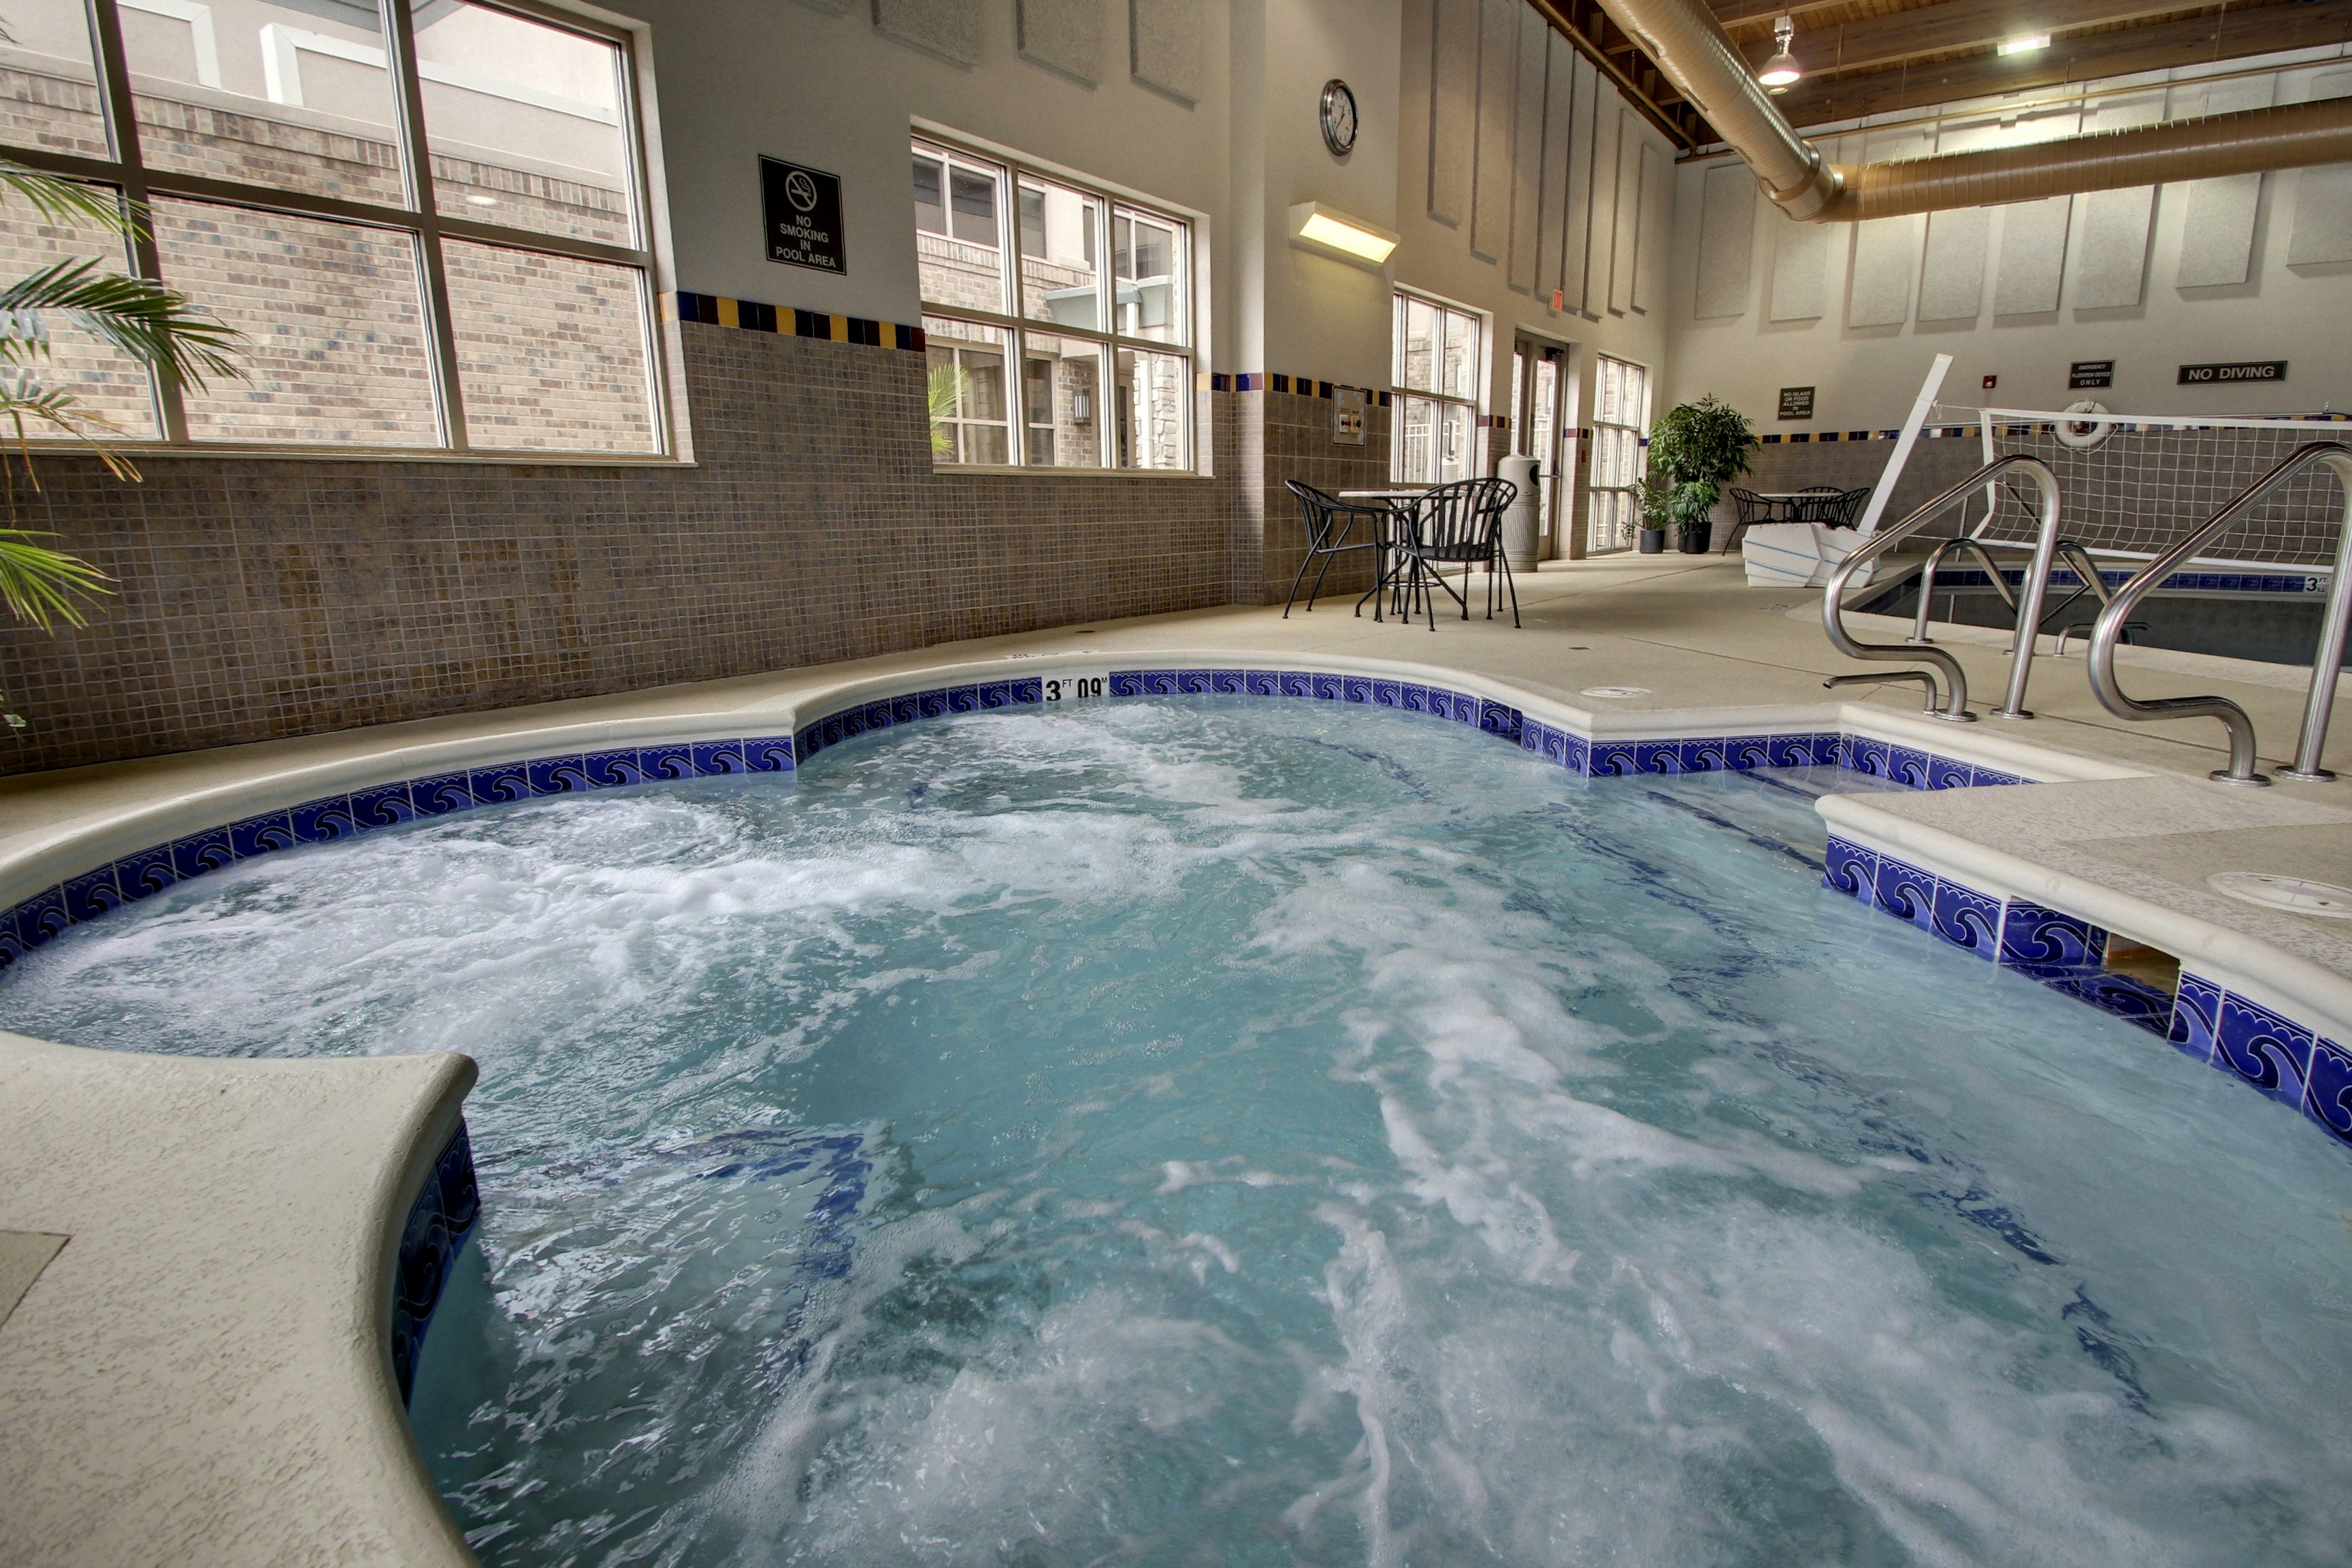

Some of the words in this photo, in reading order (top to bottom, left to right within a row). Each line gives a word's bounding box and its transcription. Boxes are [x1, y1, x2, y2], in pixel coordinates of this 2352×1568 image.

[796, 214, 811, 228] NO
[780, 223, 829, 243] SMOKING
[800, 239, 811, 251] IN
[776, 246, 806, 262] POOL
[808, 255, 836, 267] AREA
[2188, 369, 2212, 380] NO
[2219, 366, 2274, 379] DIVING
[2306, 577, 2318, 591] 3
[1046, 680, 1061, 701] 3
[1062, 679, 1073, 688] FT
